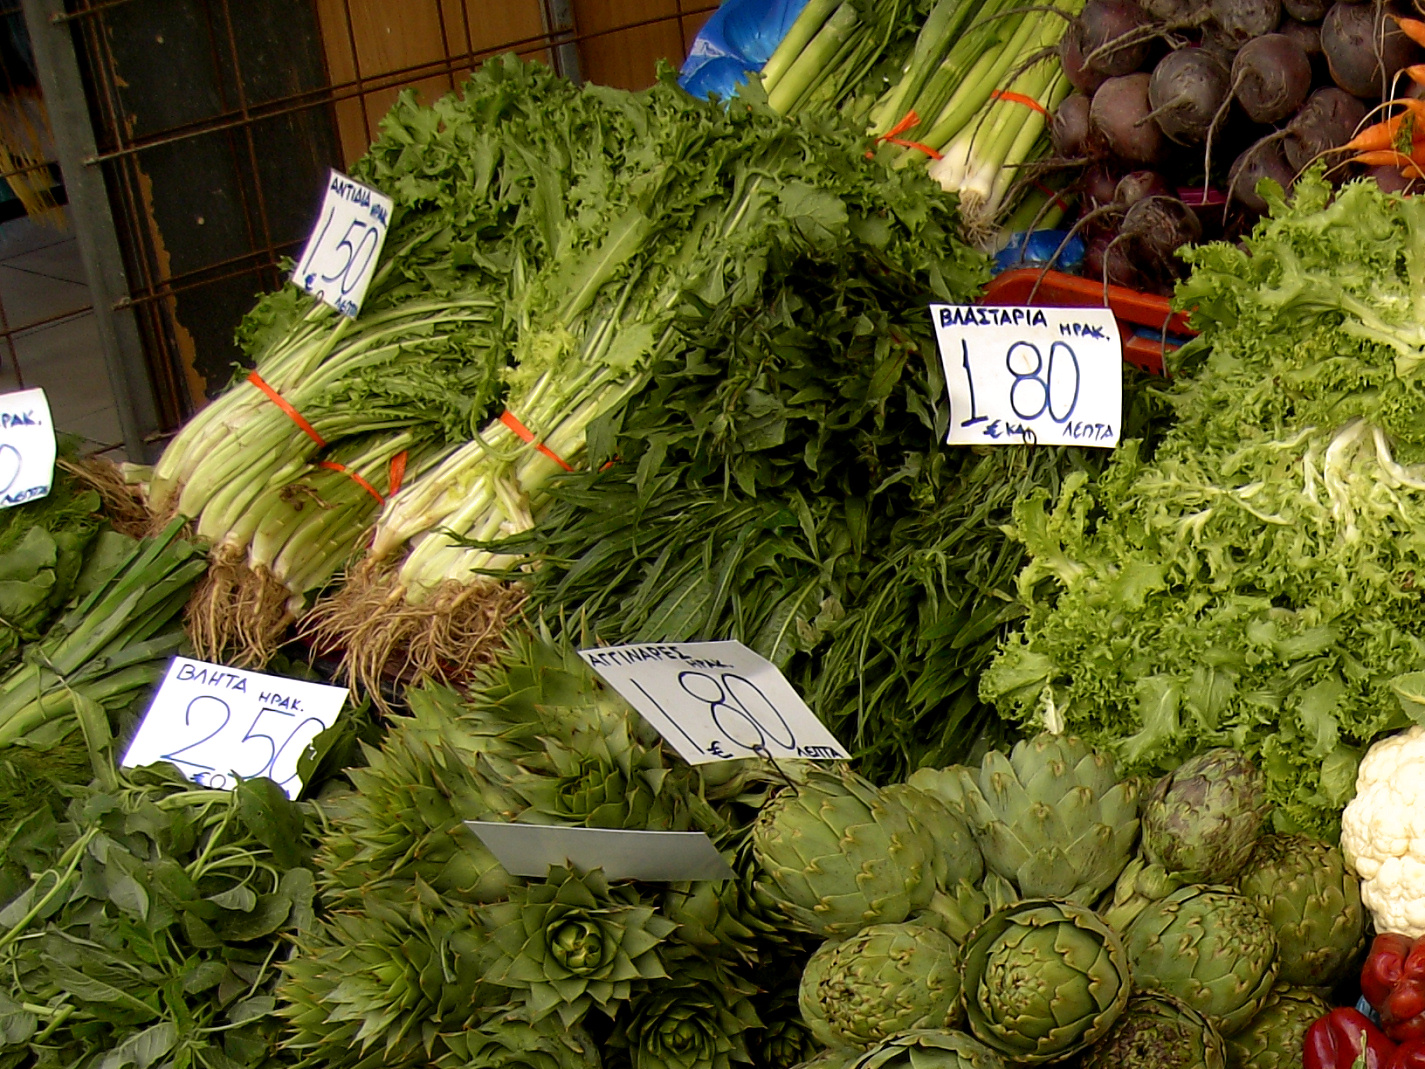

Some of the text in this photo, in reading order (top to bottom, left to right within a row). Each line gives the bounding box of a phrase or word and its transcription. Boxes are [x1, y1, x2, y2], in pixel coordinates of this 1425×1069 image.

[939, 307, 1048, 328] ΒΛΑΣΤΑΡΙΑ
[0, 409, 42, 429] ΡΑΚ.
[176, 663, 247, 694] ΒΛΗΤΑ
